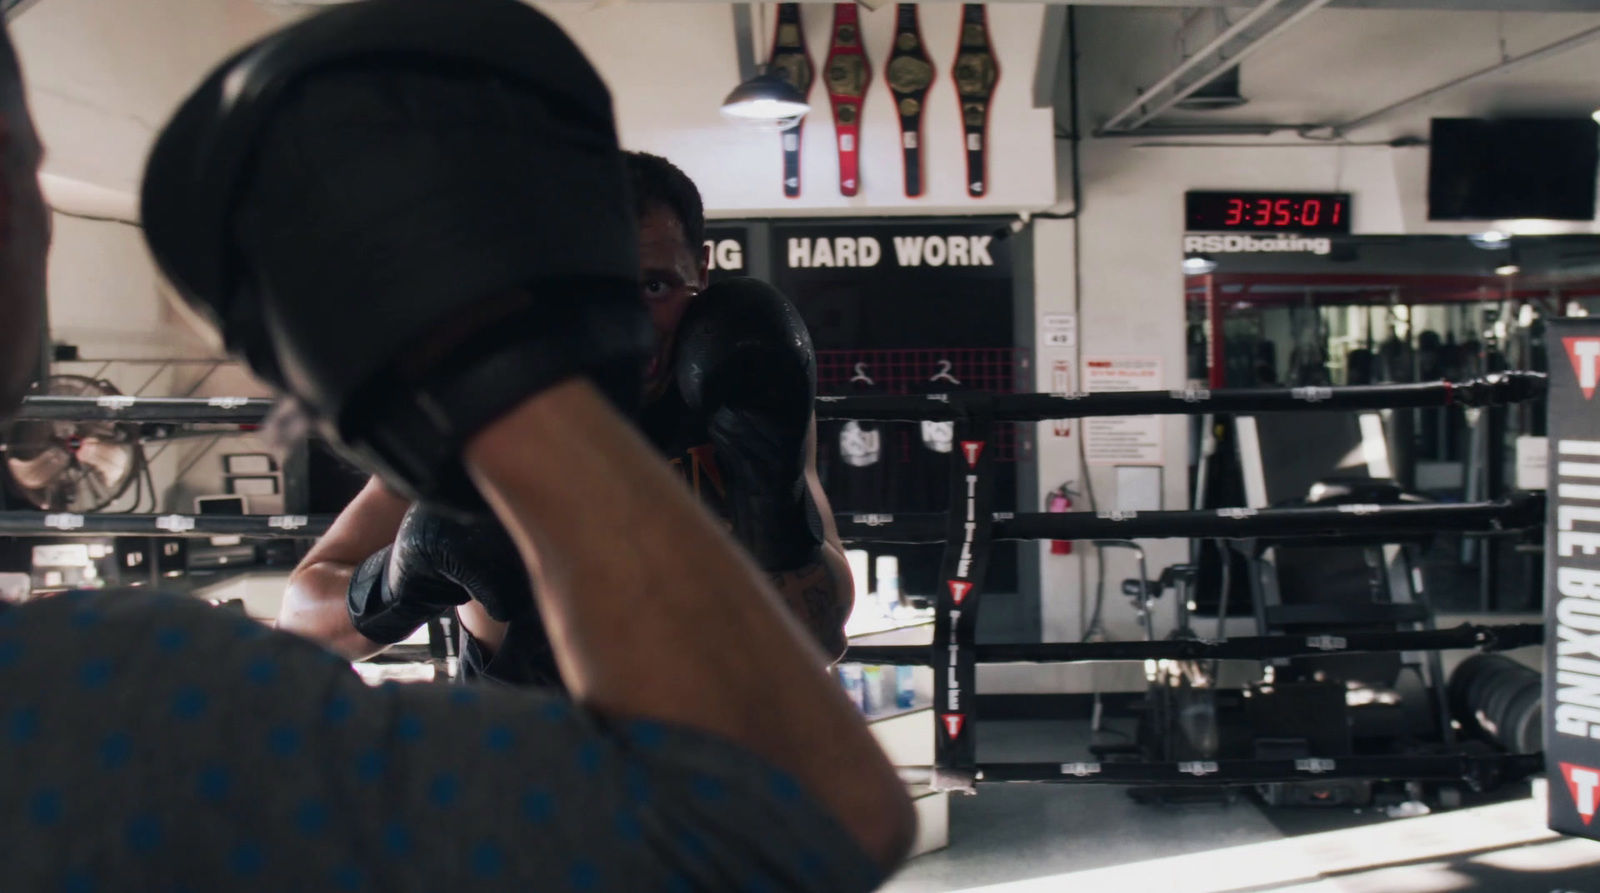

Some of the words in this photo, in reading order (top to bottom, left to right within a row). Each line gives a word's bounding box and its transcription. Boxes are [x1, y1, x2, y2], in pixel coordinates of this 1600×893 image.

[1224, 198, 1341, 226] 3:35:01
[788, 237, 881, 268] HARD
[893, 236, 994, 267] WORK
[1184, 235, 1331, 254] RSDboxing
[1574, 340, 1600, 388] T
[965, 443, 979, 464] T
[957, 475, 978, 578] TITLE
[952, 583, 967, 601] T
[948, 610, 962, 711] TITLE
[1556, 566, 1600, 740] BOXING
[946, 715, 960, 735] T
[1571, 768, 1599, 816] T
